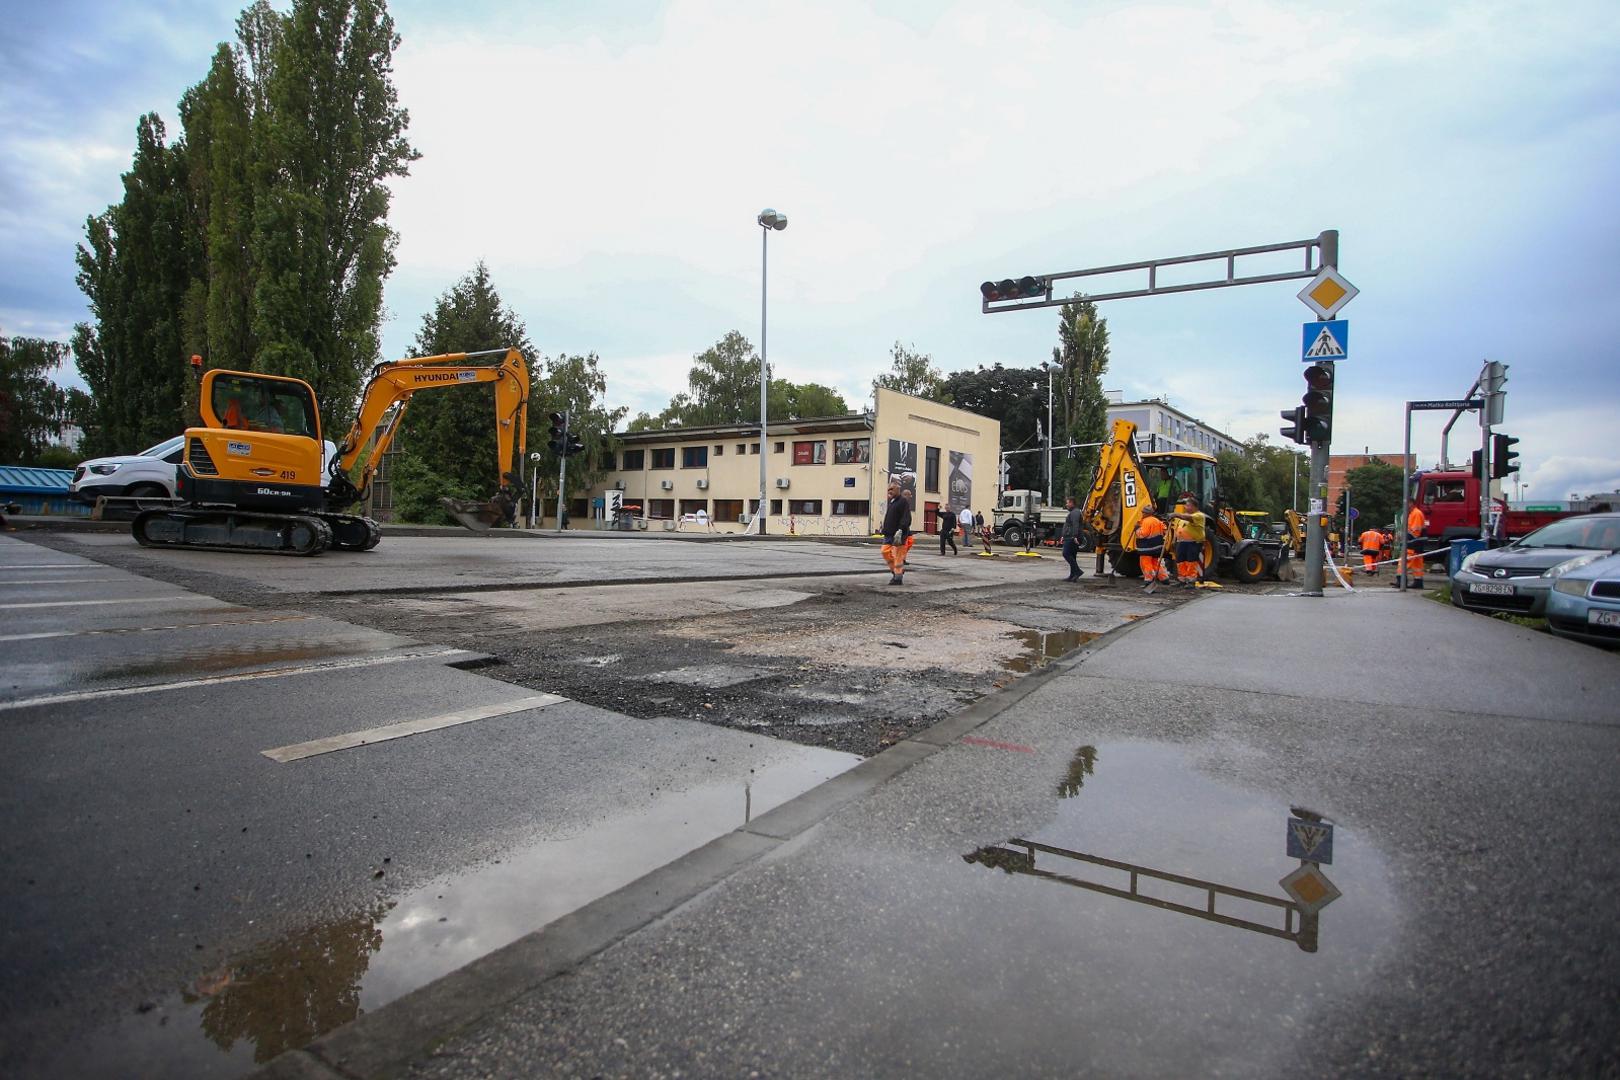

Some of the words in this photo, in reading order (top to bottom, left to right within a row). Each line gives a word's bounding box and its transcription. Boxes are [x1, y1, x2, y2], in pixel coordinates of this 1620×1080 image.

[414, 373, 459, 382] HYUNDAI
[280, 471, 296, 480] 419
[1124, 472, 1136, 508] JCB
[1597, 611, 1611, 624] ZG
